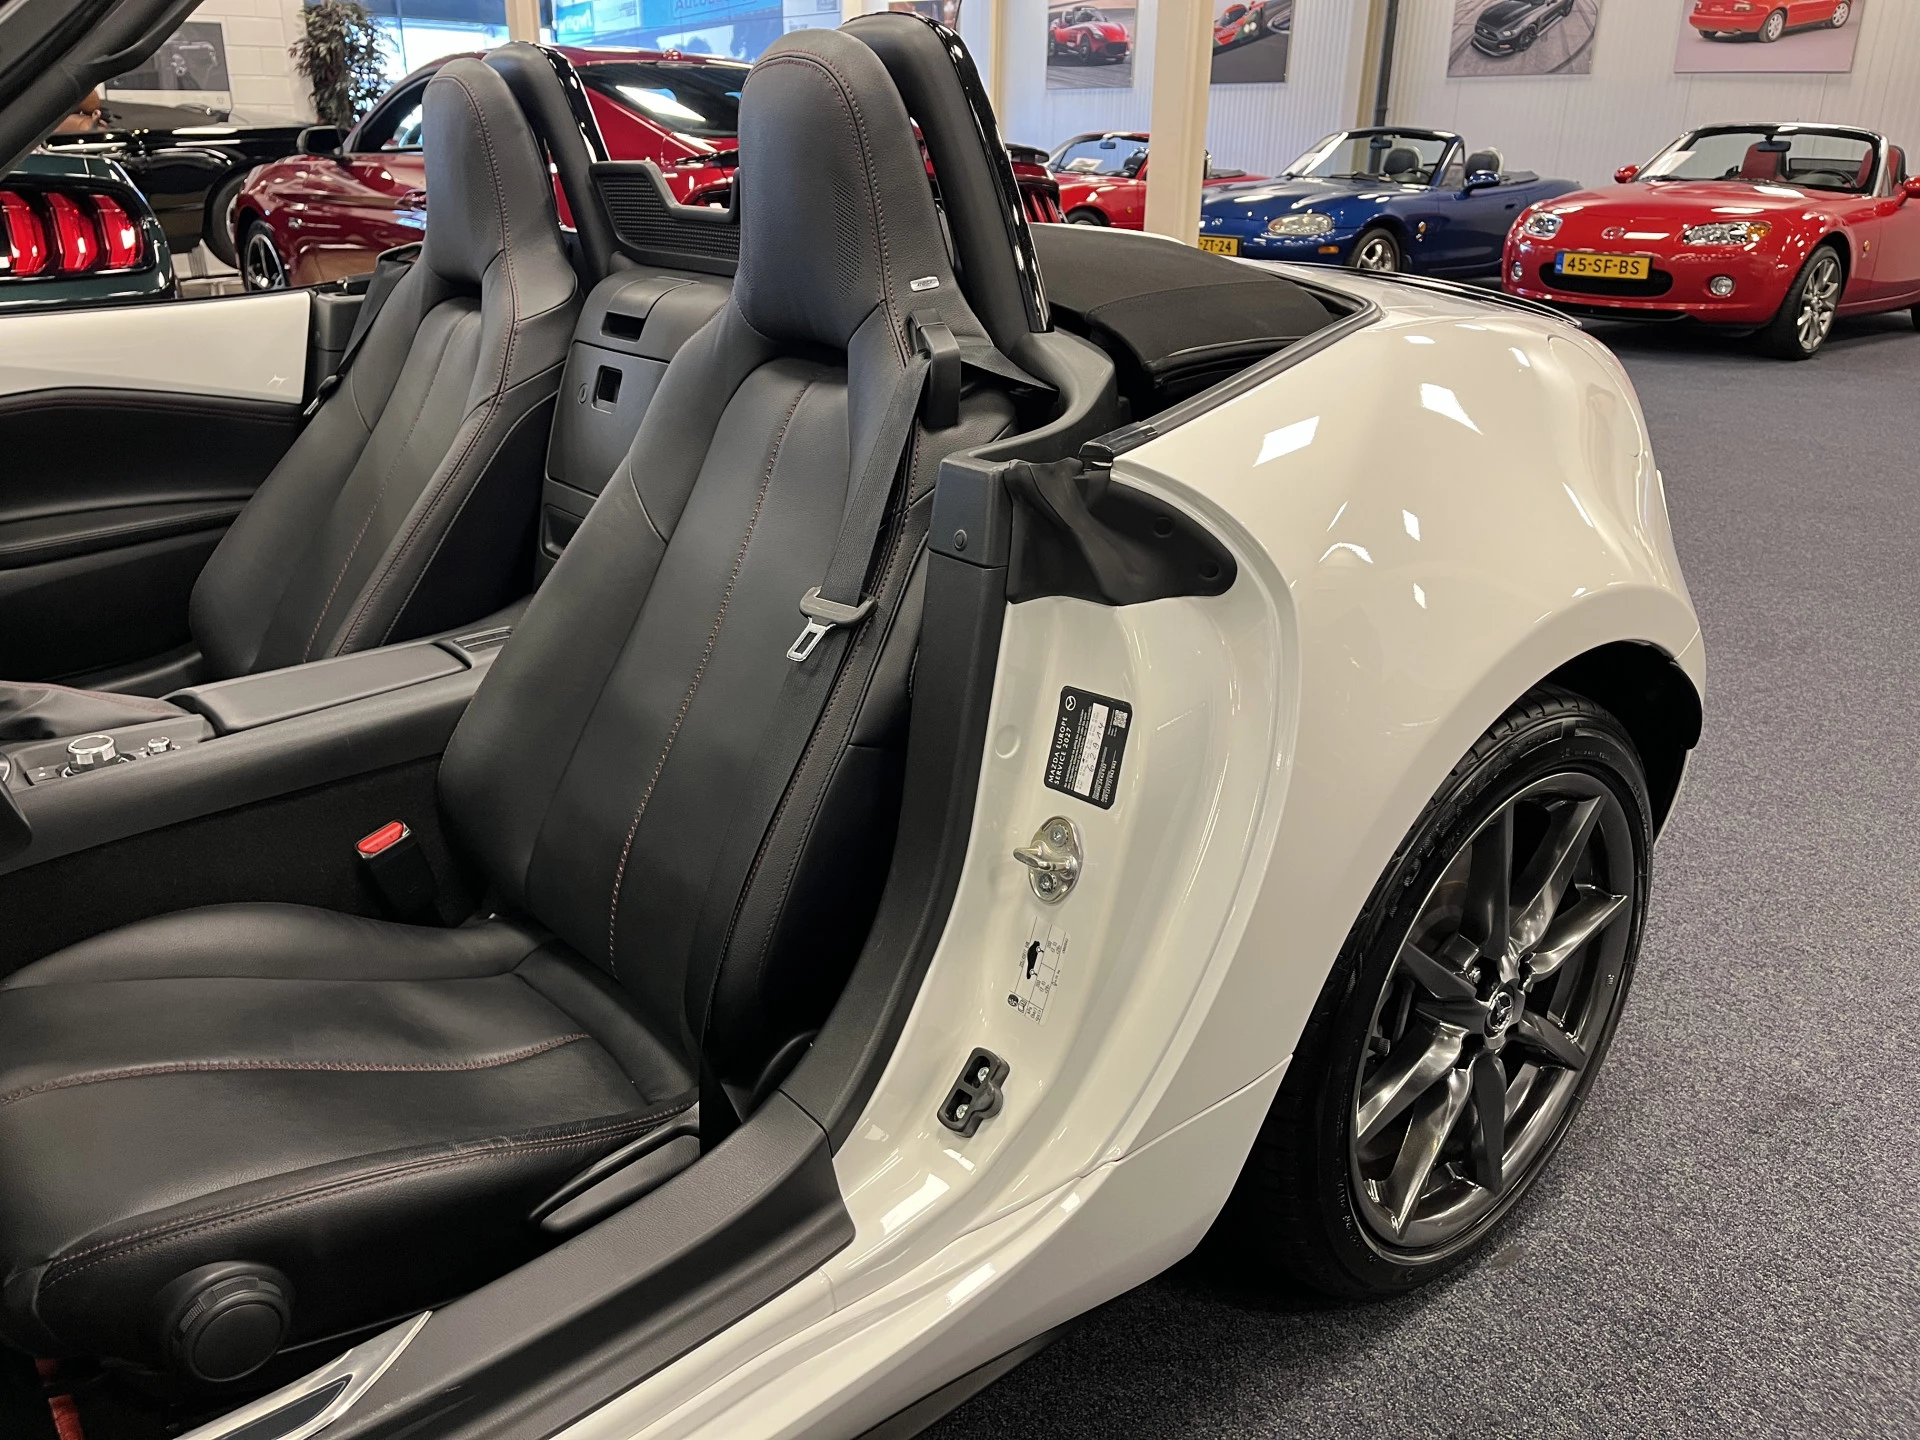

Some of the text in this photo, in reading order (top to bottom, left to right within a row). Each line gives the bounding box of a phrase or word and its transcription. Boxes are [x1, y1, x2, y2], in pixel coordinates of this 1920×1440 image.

[1199, 239, 1231, 253] -ZT-24
[1568, 257, 1640, 275] 45-SF-BS
[1048, 716, 1068, 783] MAZDA EUROPE
[1054, 727, 1072, 785] SERVICE 2027
